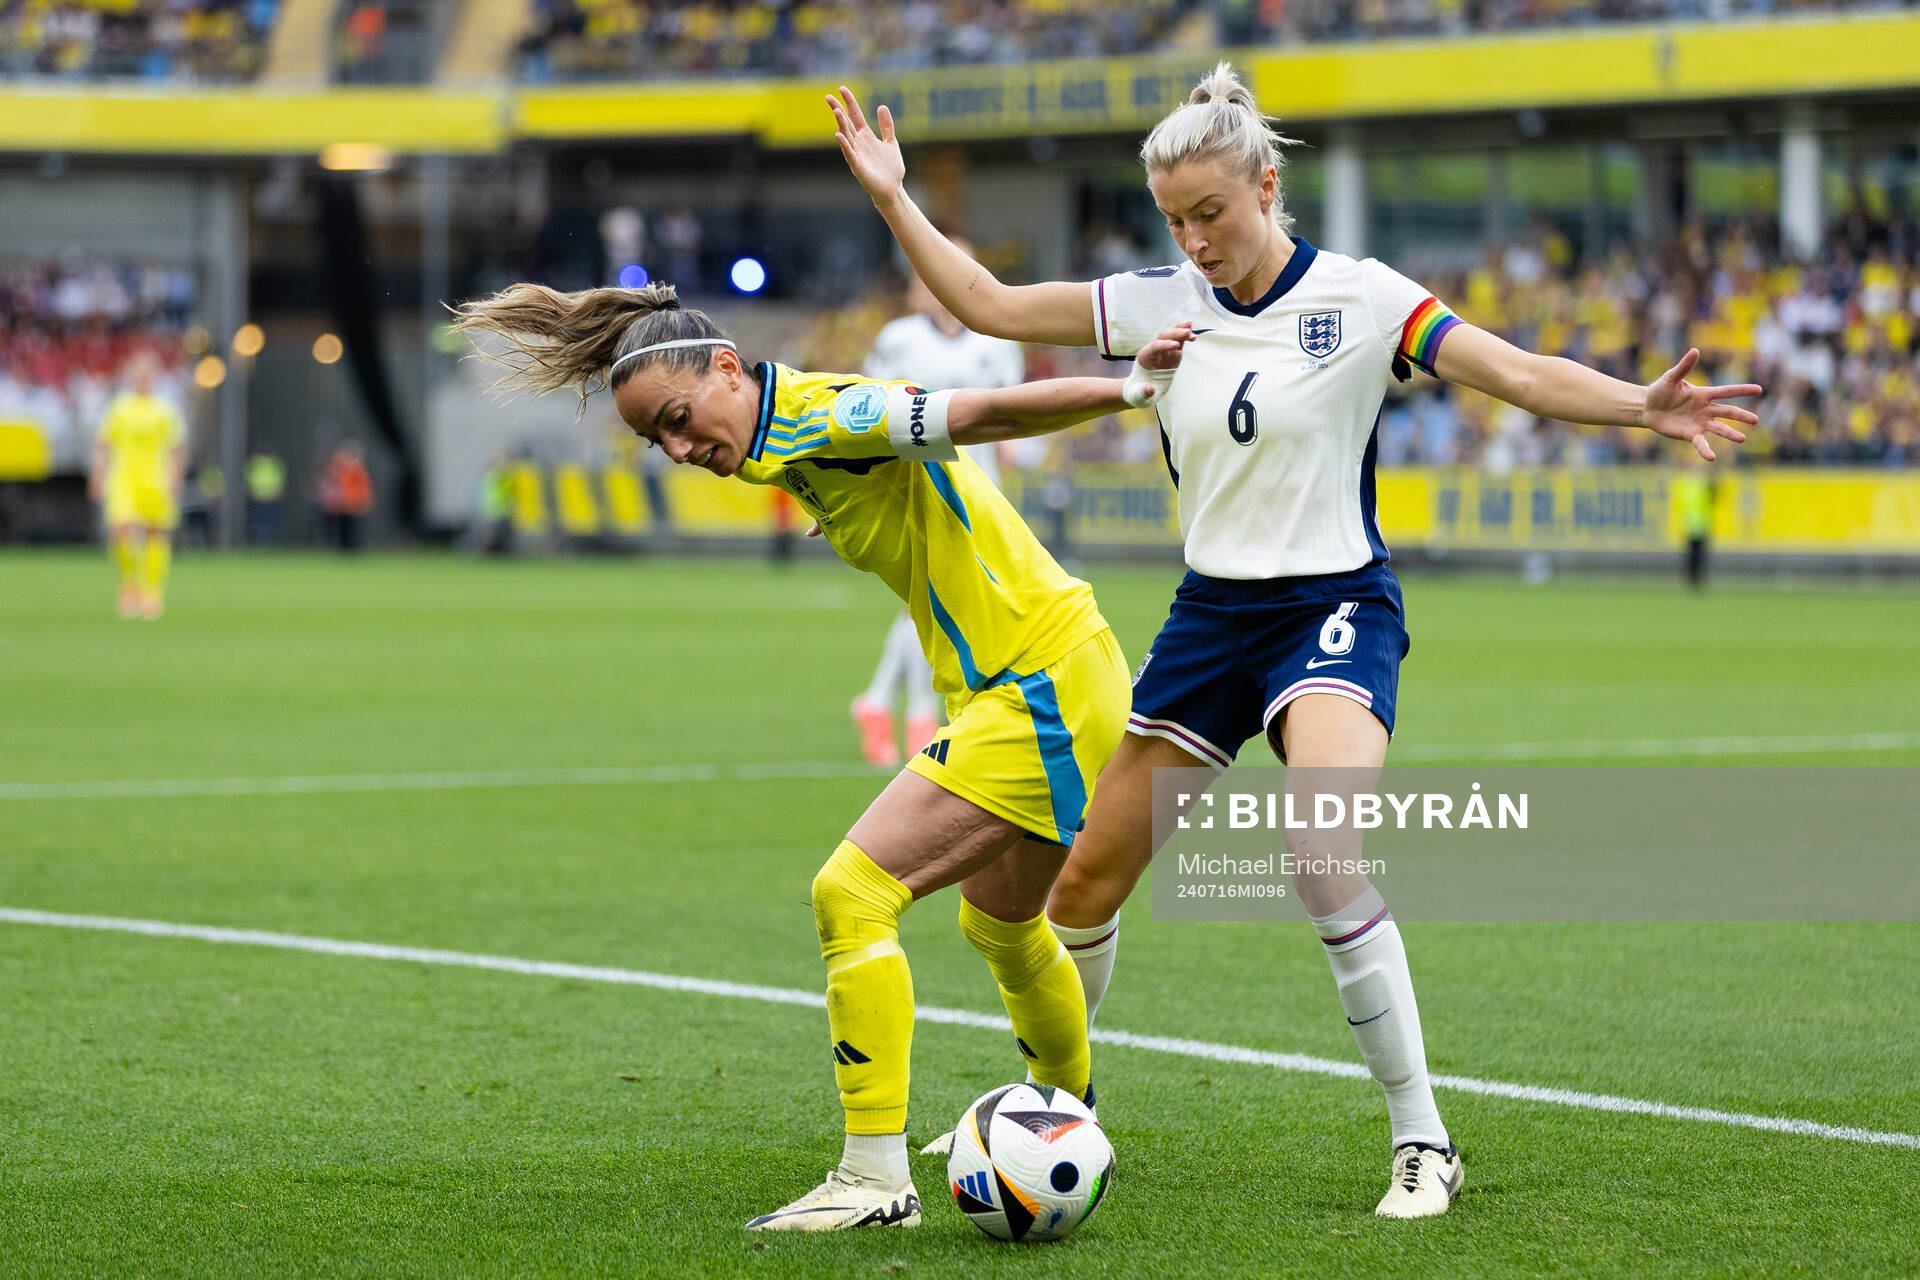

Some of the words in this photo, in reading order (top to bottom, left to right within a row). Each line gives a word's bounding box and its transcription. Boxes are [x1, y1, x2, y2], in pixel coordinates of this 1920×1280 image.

[910, 396, 928, 447] #ONE
[1228, 371, 1259, 446] 6
[1318, 602, 1359, 656] 6
